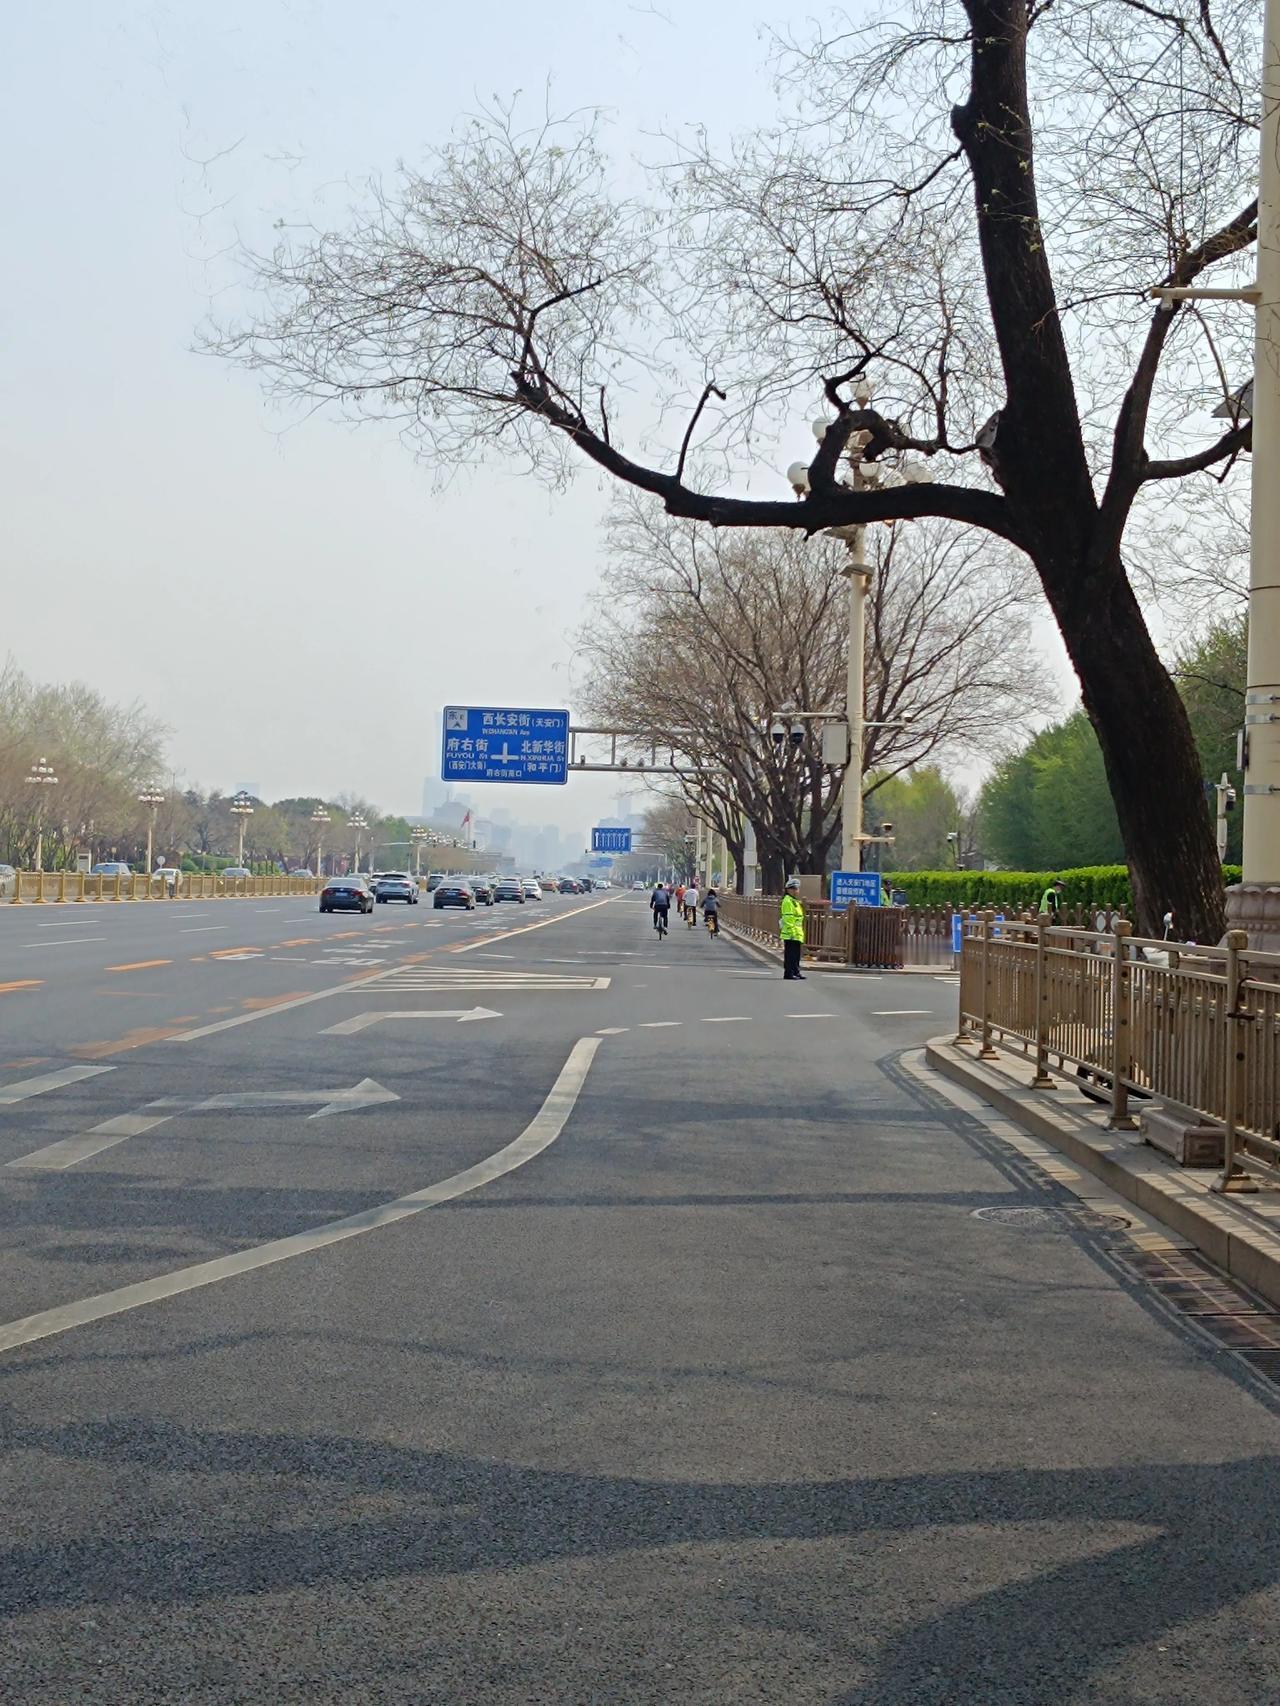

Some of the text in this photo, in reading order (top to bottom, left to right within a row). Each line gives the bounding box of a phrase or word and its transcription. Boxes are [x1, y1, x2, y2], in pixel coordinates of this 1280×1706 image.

[482, 712, 530, 727] 西长安街
[447, 738, 488, 752] 府右街
[521, 740, 565, 754] 北新华街
